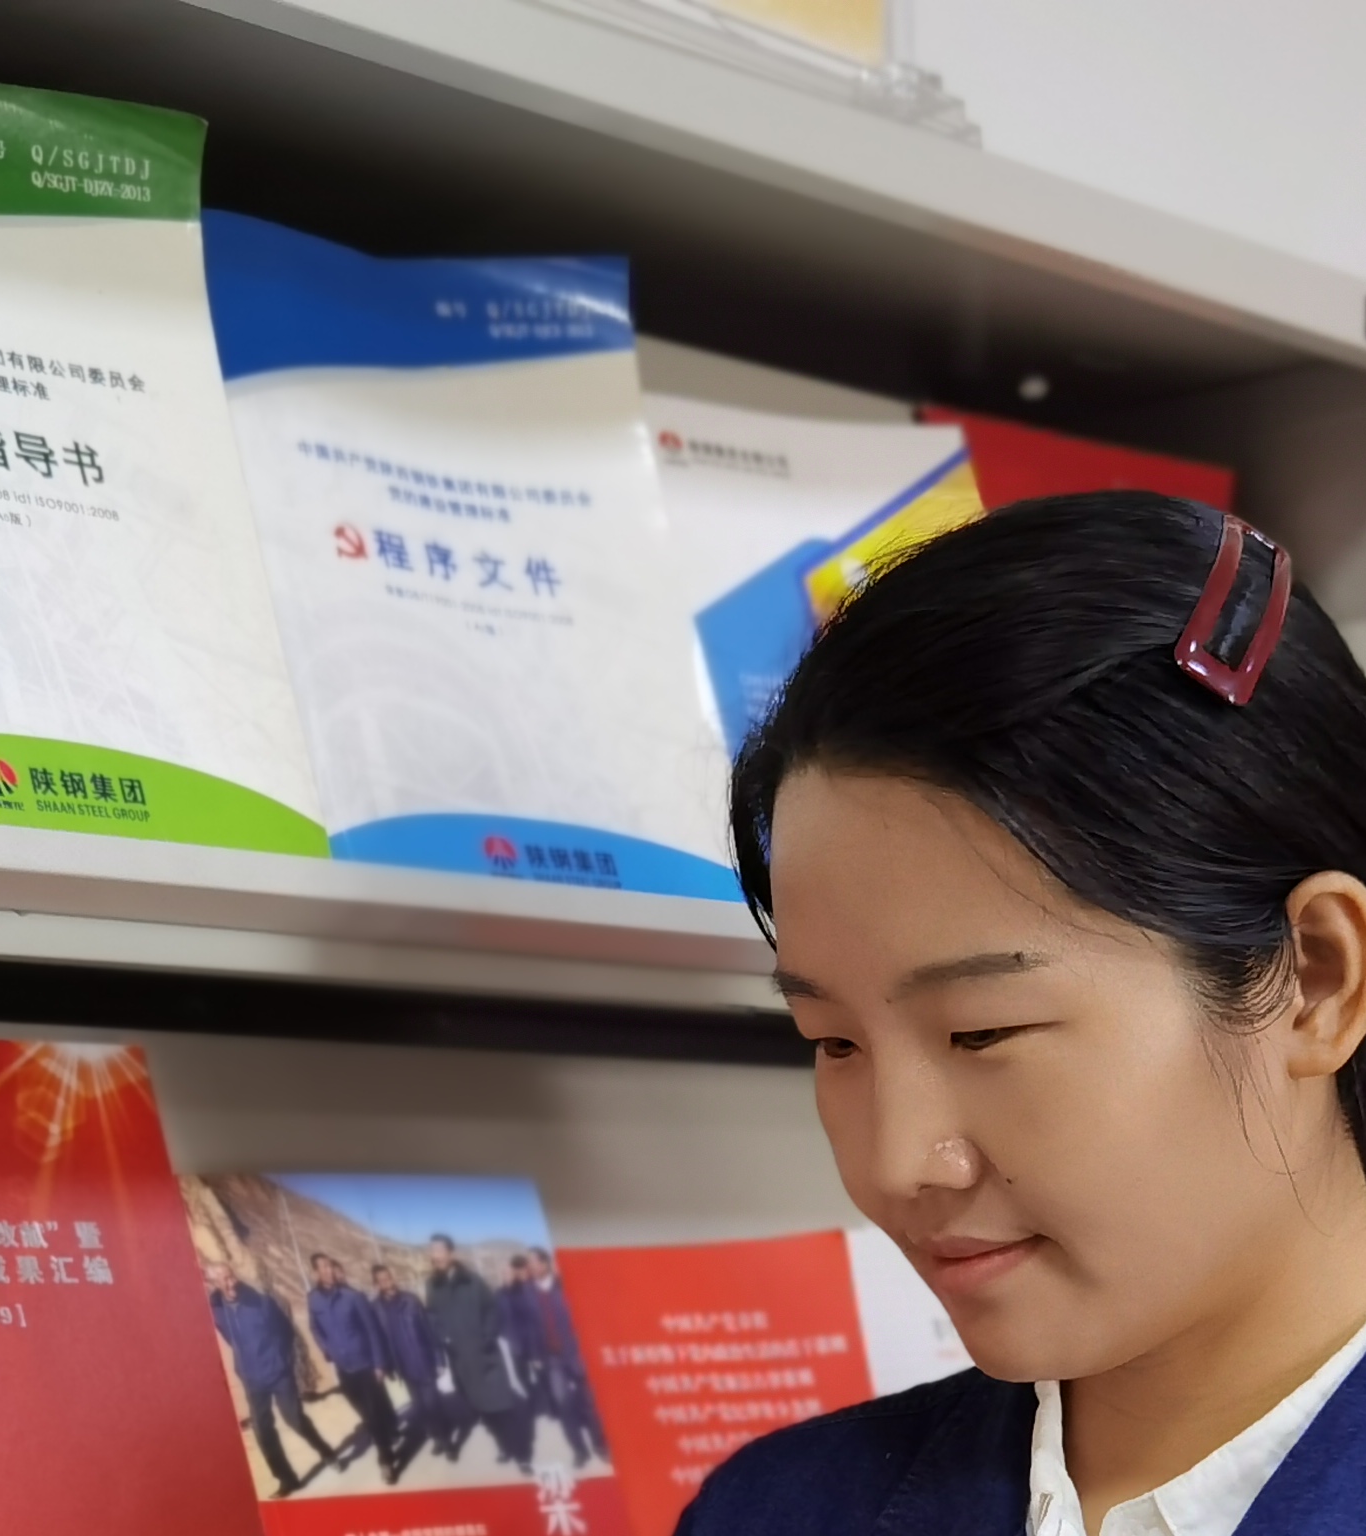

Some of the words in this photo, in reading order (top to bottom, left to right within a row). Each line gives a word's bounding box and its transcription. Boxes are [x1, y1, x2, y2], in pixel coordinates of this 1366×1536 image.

[373, 527, 563, 598] 程序文件
[29, 767, 147, 806] 陕钢集团
[36, 800, 76, 815] SHAAN
[77, 804, 112, 819] STEEL
[112, 808, 151, 823] GROUP
